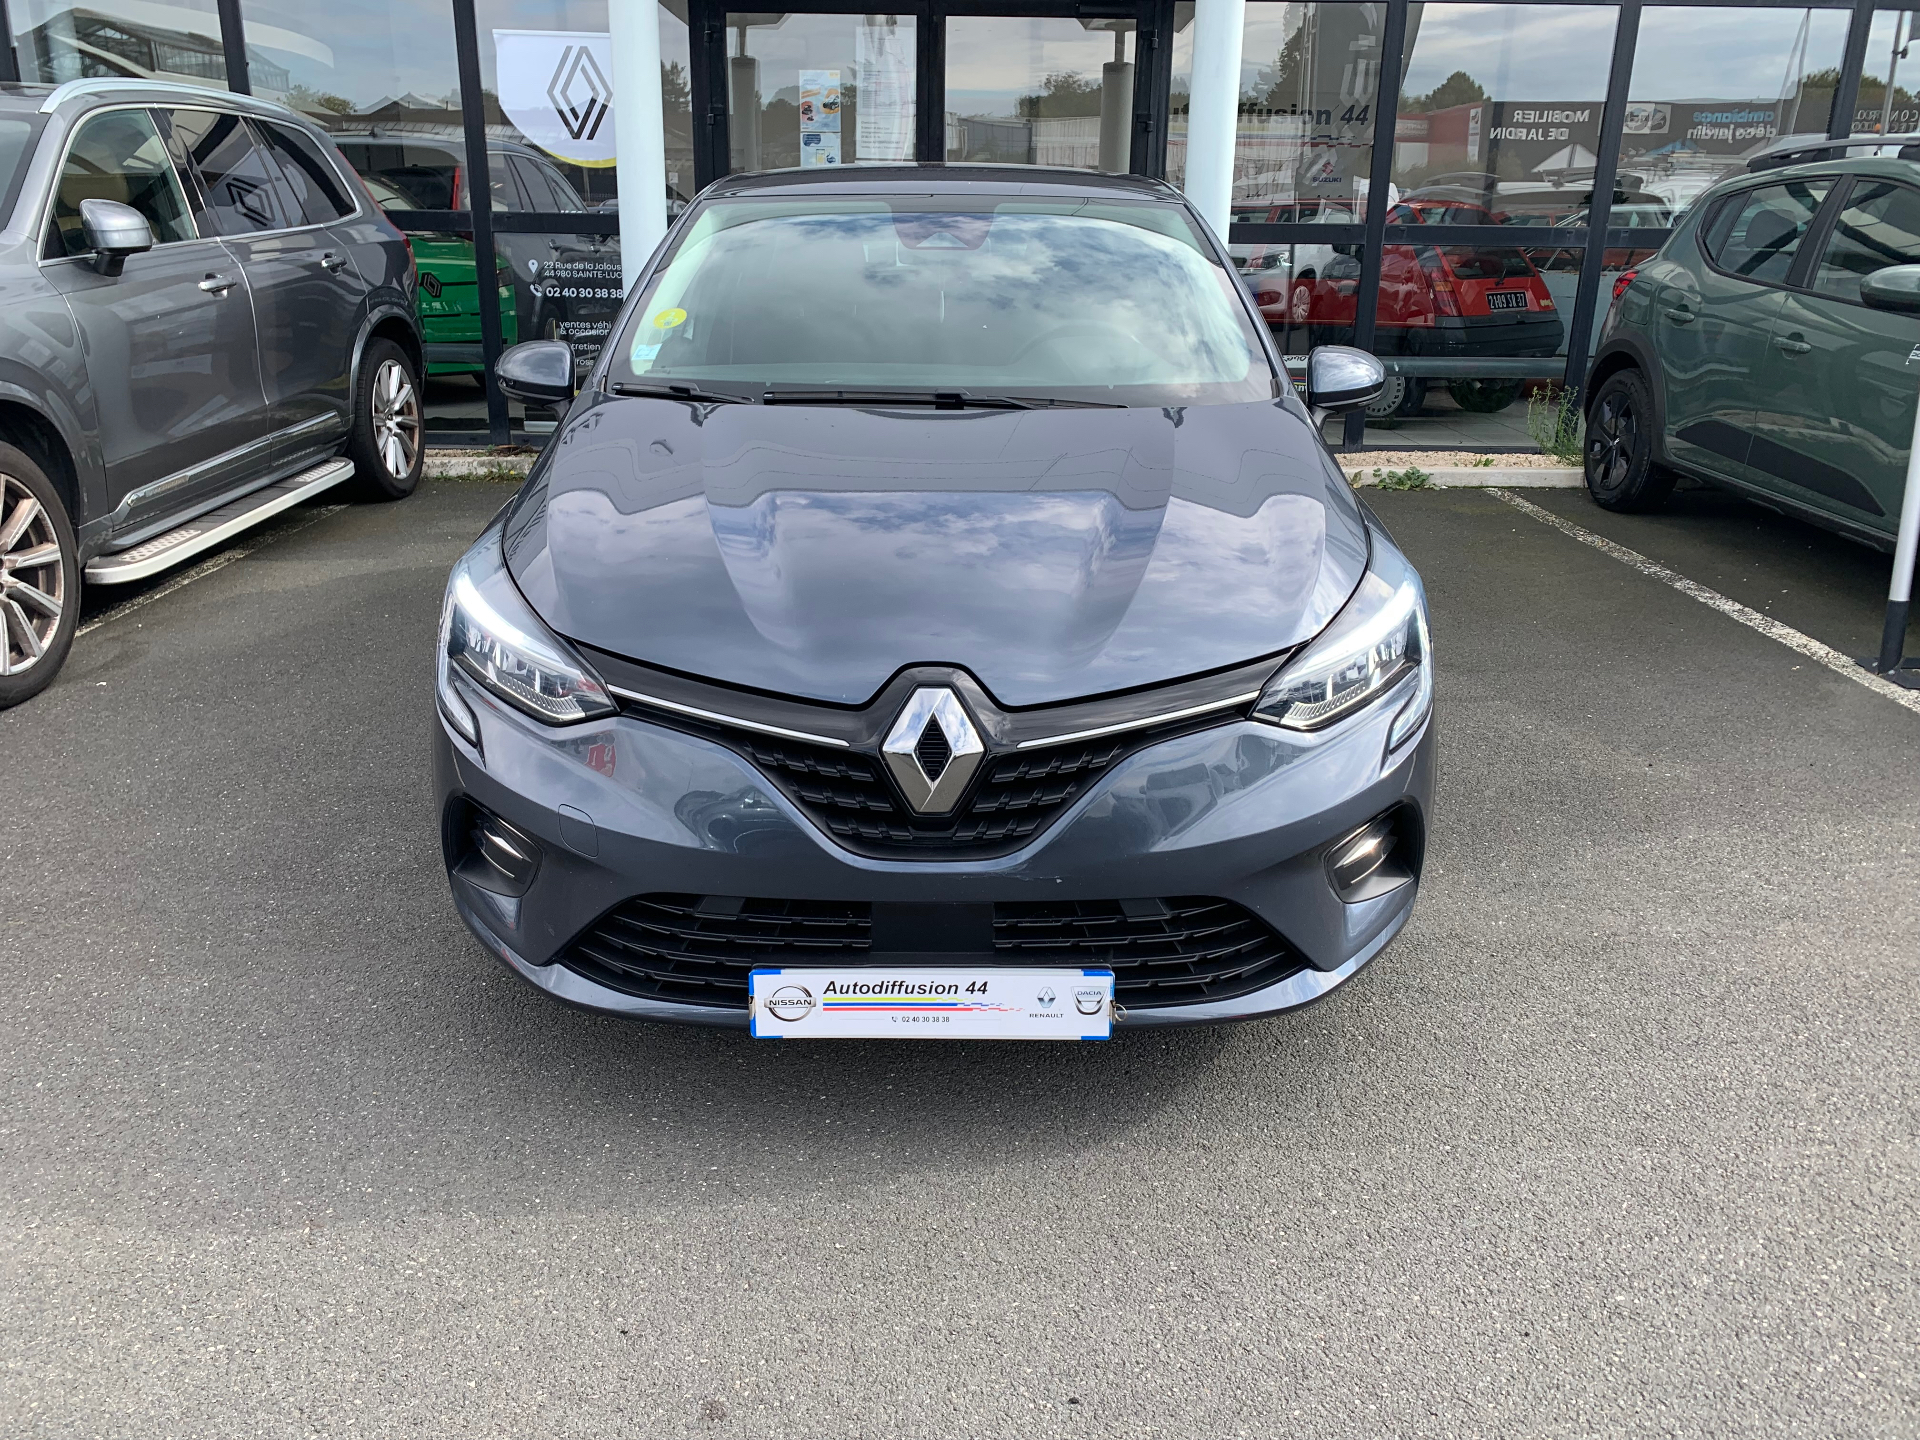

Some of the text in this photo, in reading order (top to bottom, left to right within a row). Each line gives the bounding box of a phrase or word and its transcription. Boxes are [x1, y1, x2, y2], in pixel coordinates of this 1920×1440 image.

[1340, 105, 1370, 125] 44
[543, 261, 554, 269] 22
[572, 262, 584, 270] de
[585, 262, 593, 270] la
[546, 287, 623, 298] 02 40 30 38 38
[559, 321, 591, 329] ventes
[823, 980, 989, 995] Autodiffusion 44
